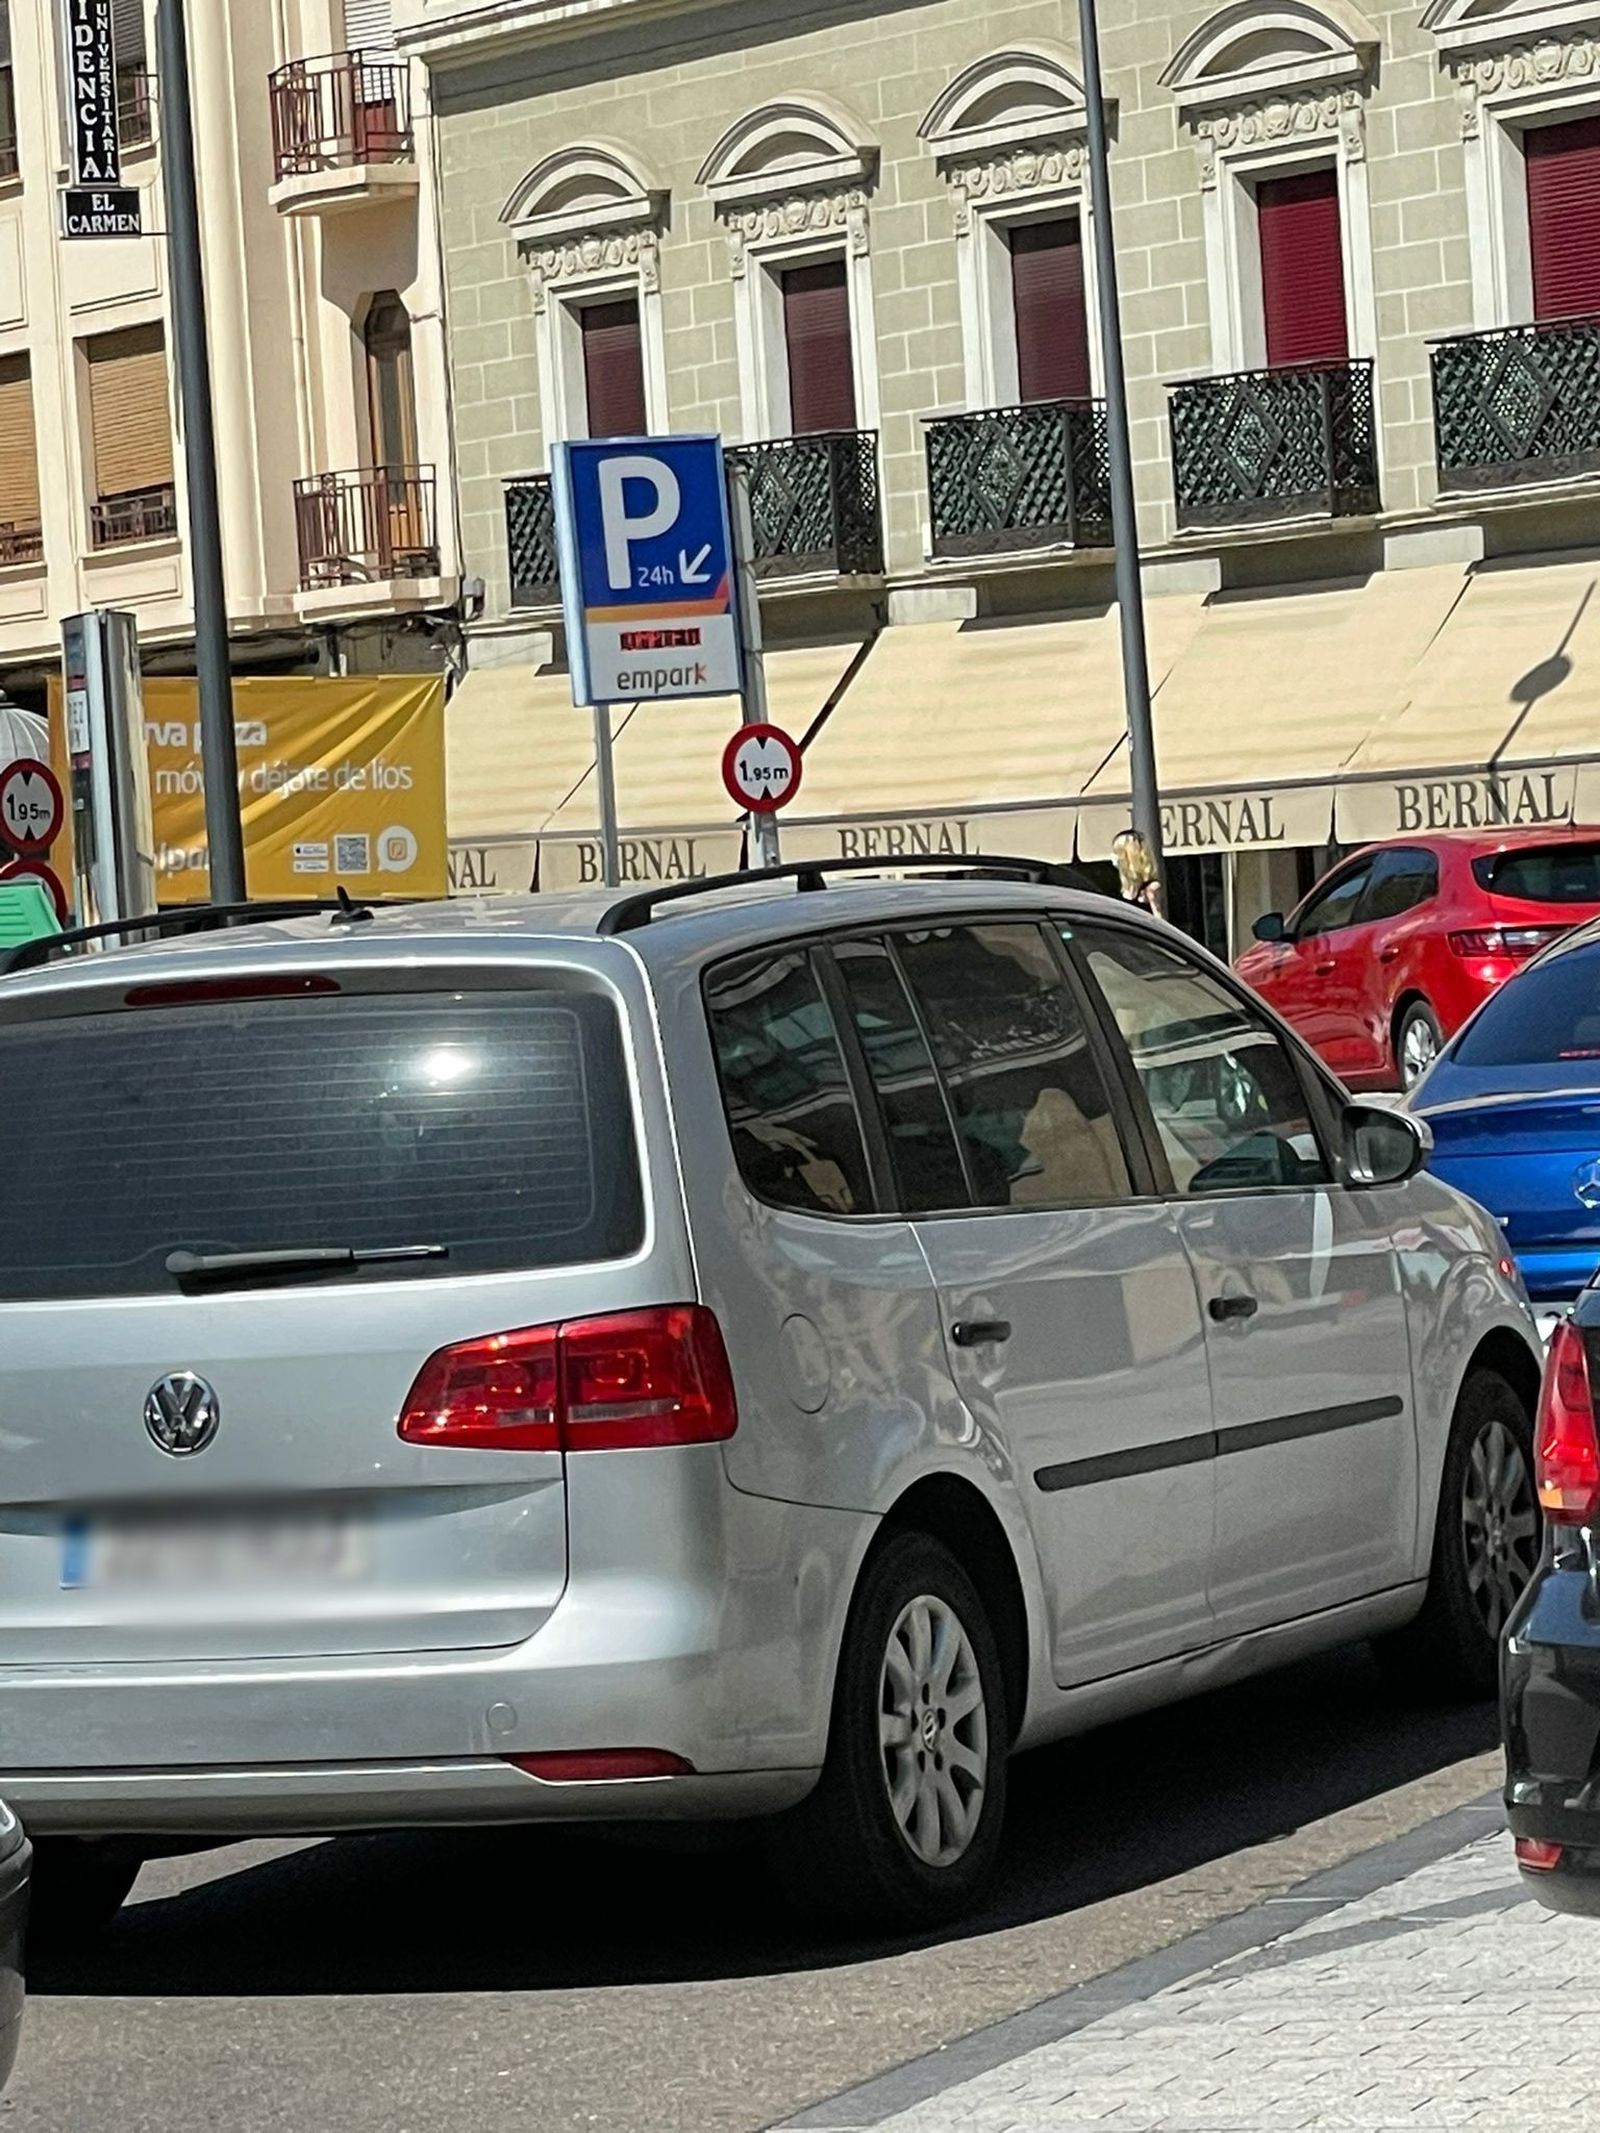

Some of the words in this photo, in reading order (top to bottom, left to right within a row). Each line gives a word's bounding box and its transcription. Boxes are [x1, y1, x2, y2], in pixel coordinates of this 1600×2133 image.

[96, 3, 117, 178] UNIVERSITARIA
[91, 193, 115, 211] EL
[68, 213, 140, 234] CARMEN
[598, 456, 680, 590] P
[637, 566, 674, 587] 24h
[617, 663, 708, 694] empark
[334, 761, 366, 791] de
[1127, 797, 1285, 848] ERNAL
[1395, 773, 1569, 831] BERNAL
